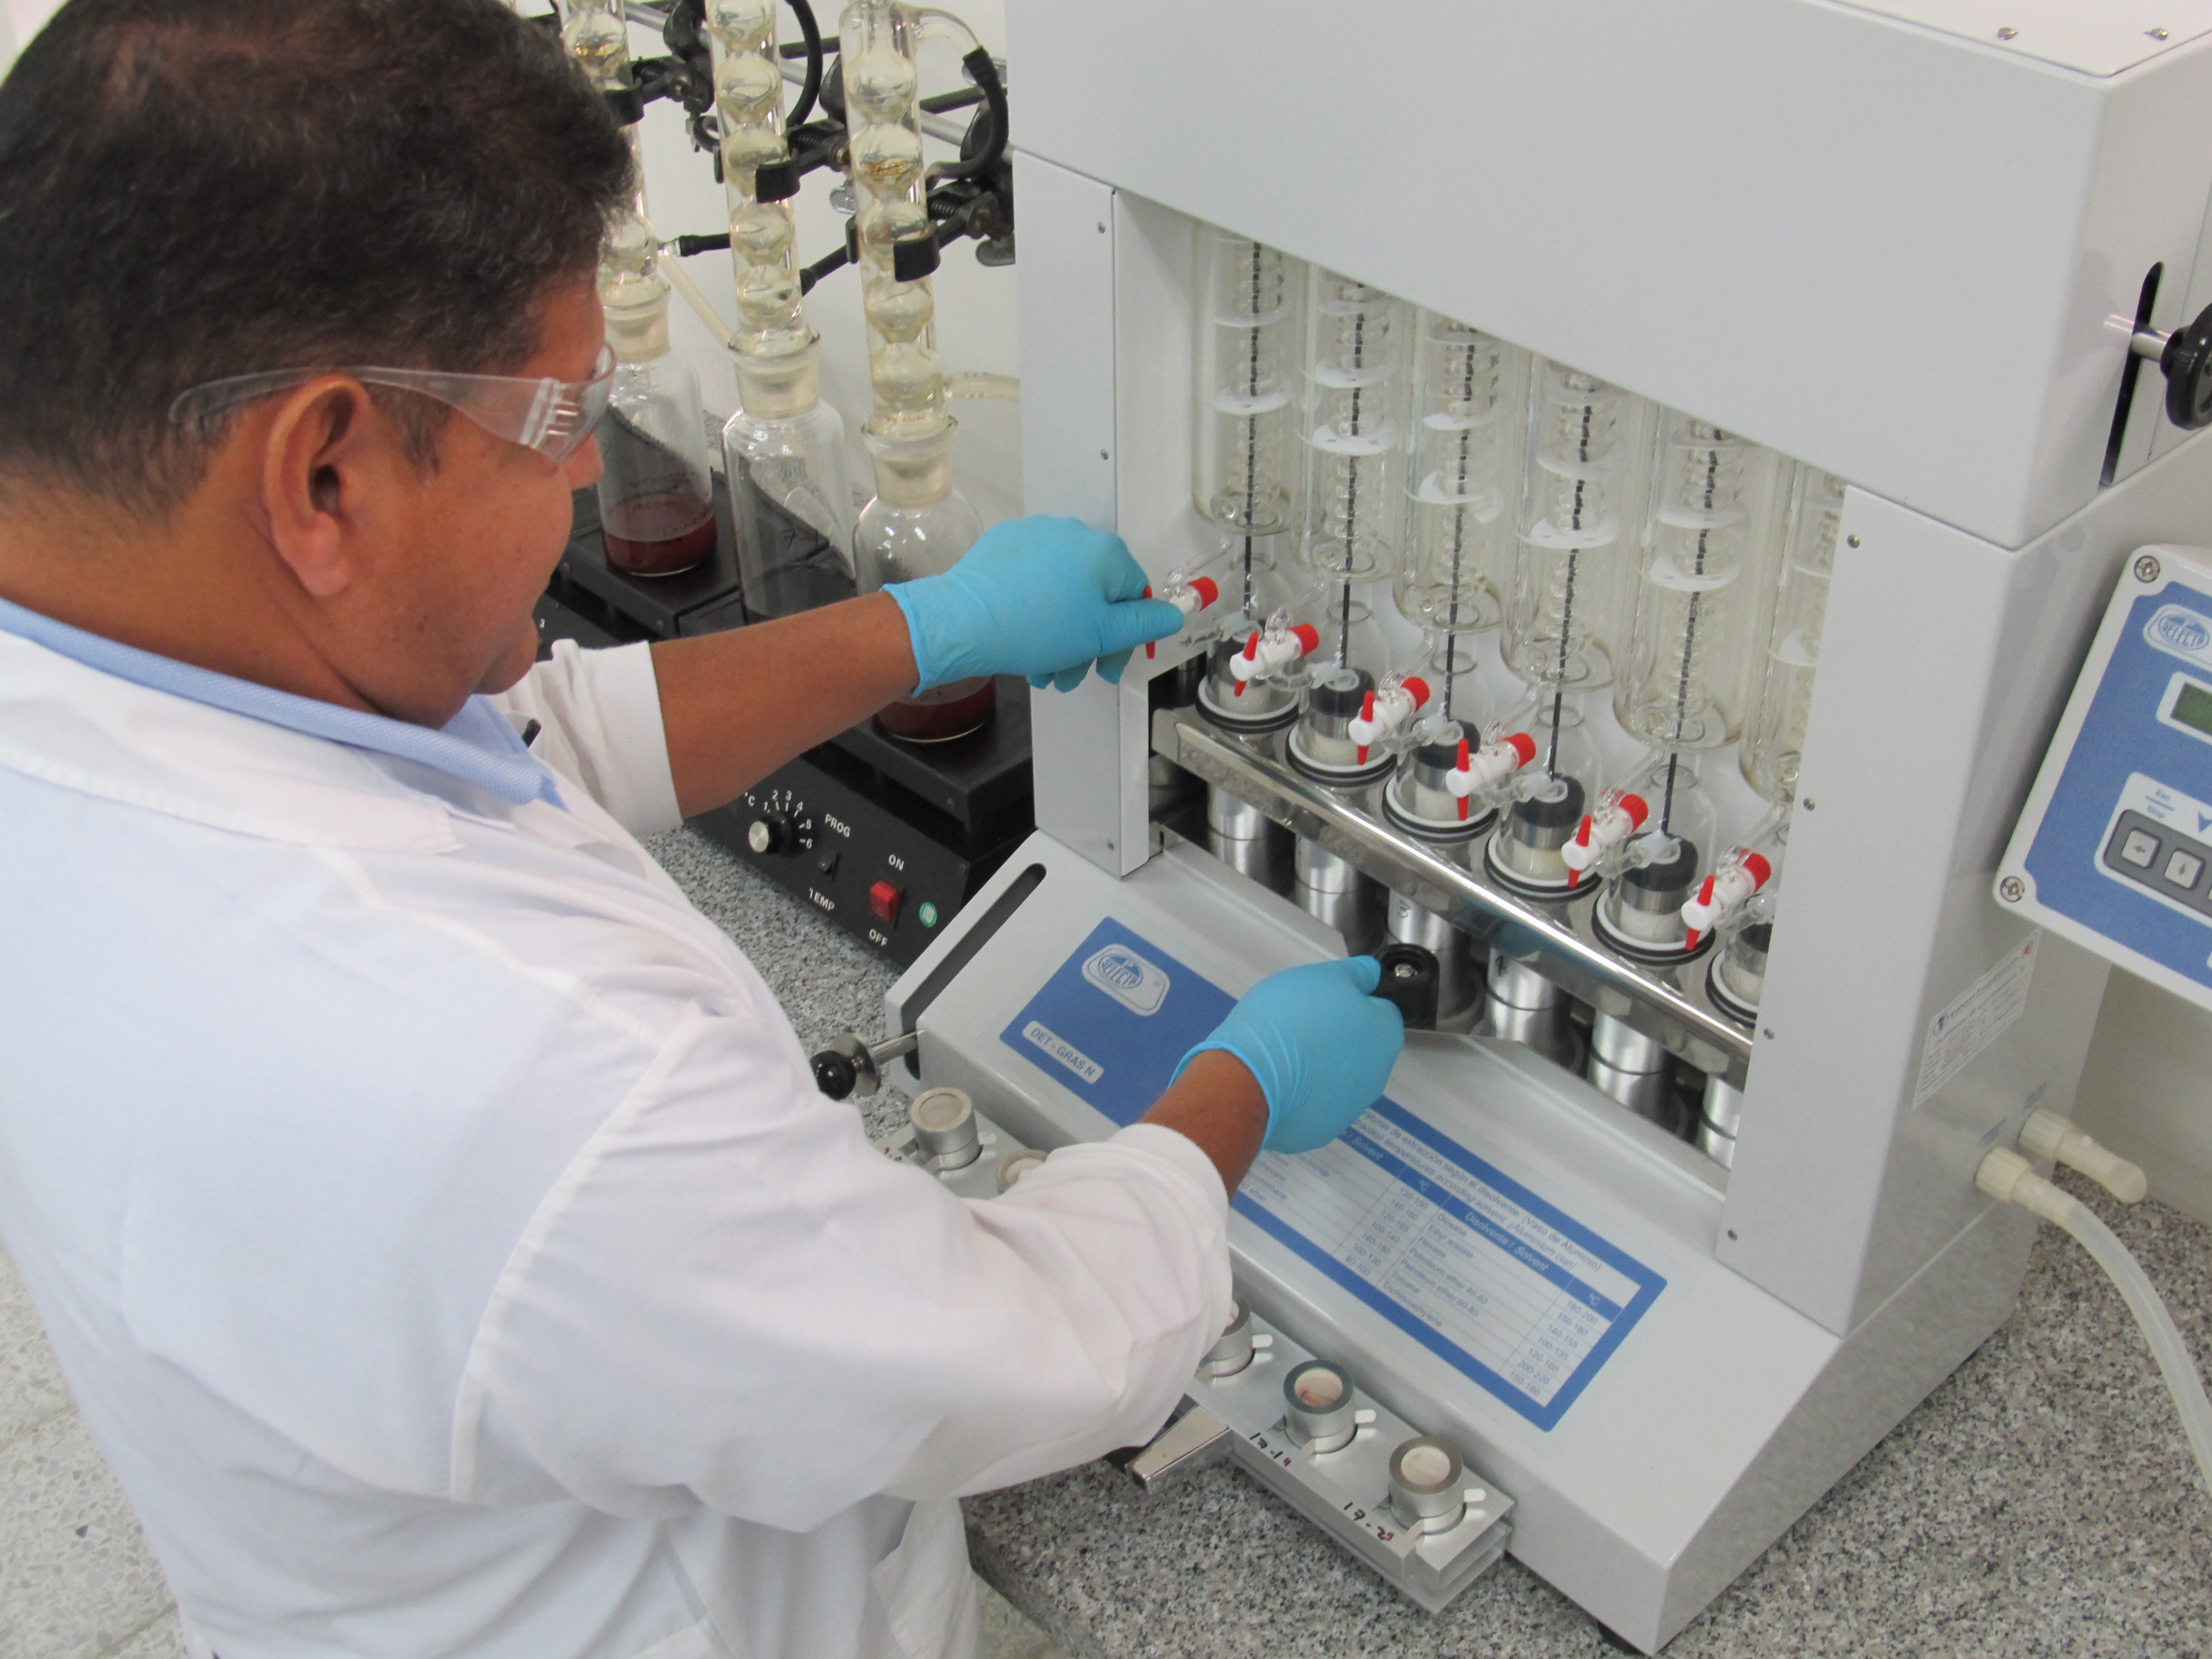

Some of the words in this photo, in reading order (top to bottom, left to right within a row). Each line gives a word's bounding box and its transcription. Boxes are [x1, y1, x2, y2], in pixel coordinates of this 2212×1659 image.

[771, 790, 778, 801] 2
[785, 790, 792, 801] 3
[797, 801, 804, 811] 4
[2147, 805, 2166, 818] Stop
[824, 813, 851, 838] PROG
[806, 838, 813, 849] 6
[888, 854, 905, 871] ON
[808, 887, 835, 912] TEMP
[869, 928, 889, 947] OFF
[1030, 1027, 1052, 1045] DET
[1057, 1046, 1087, 1070] GRAS
[1085, 1066, 1095, 1077] N
[1390, 1128, 1401, 1138] de
[1548, 1232, 1561, 1244] de
[1560, 1239, 1603, 1272] Aluminio)
[1465, 1212, 1509, 1245] Disolvente
[1515, 1245, 1549, 1271] Solvent
